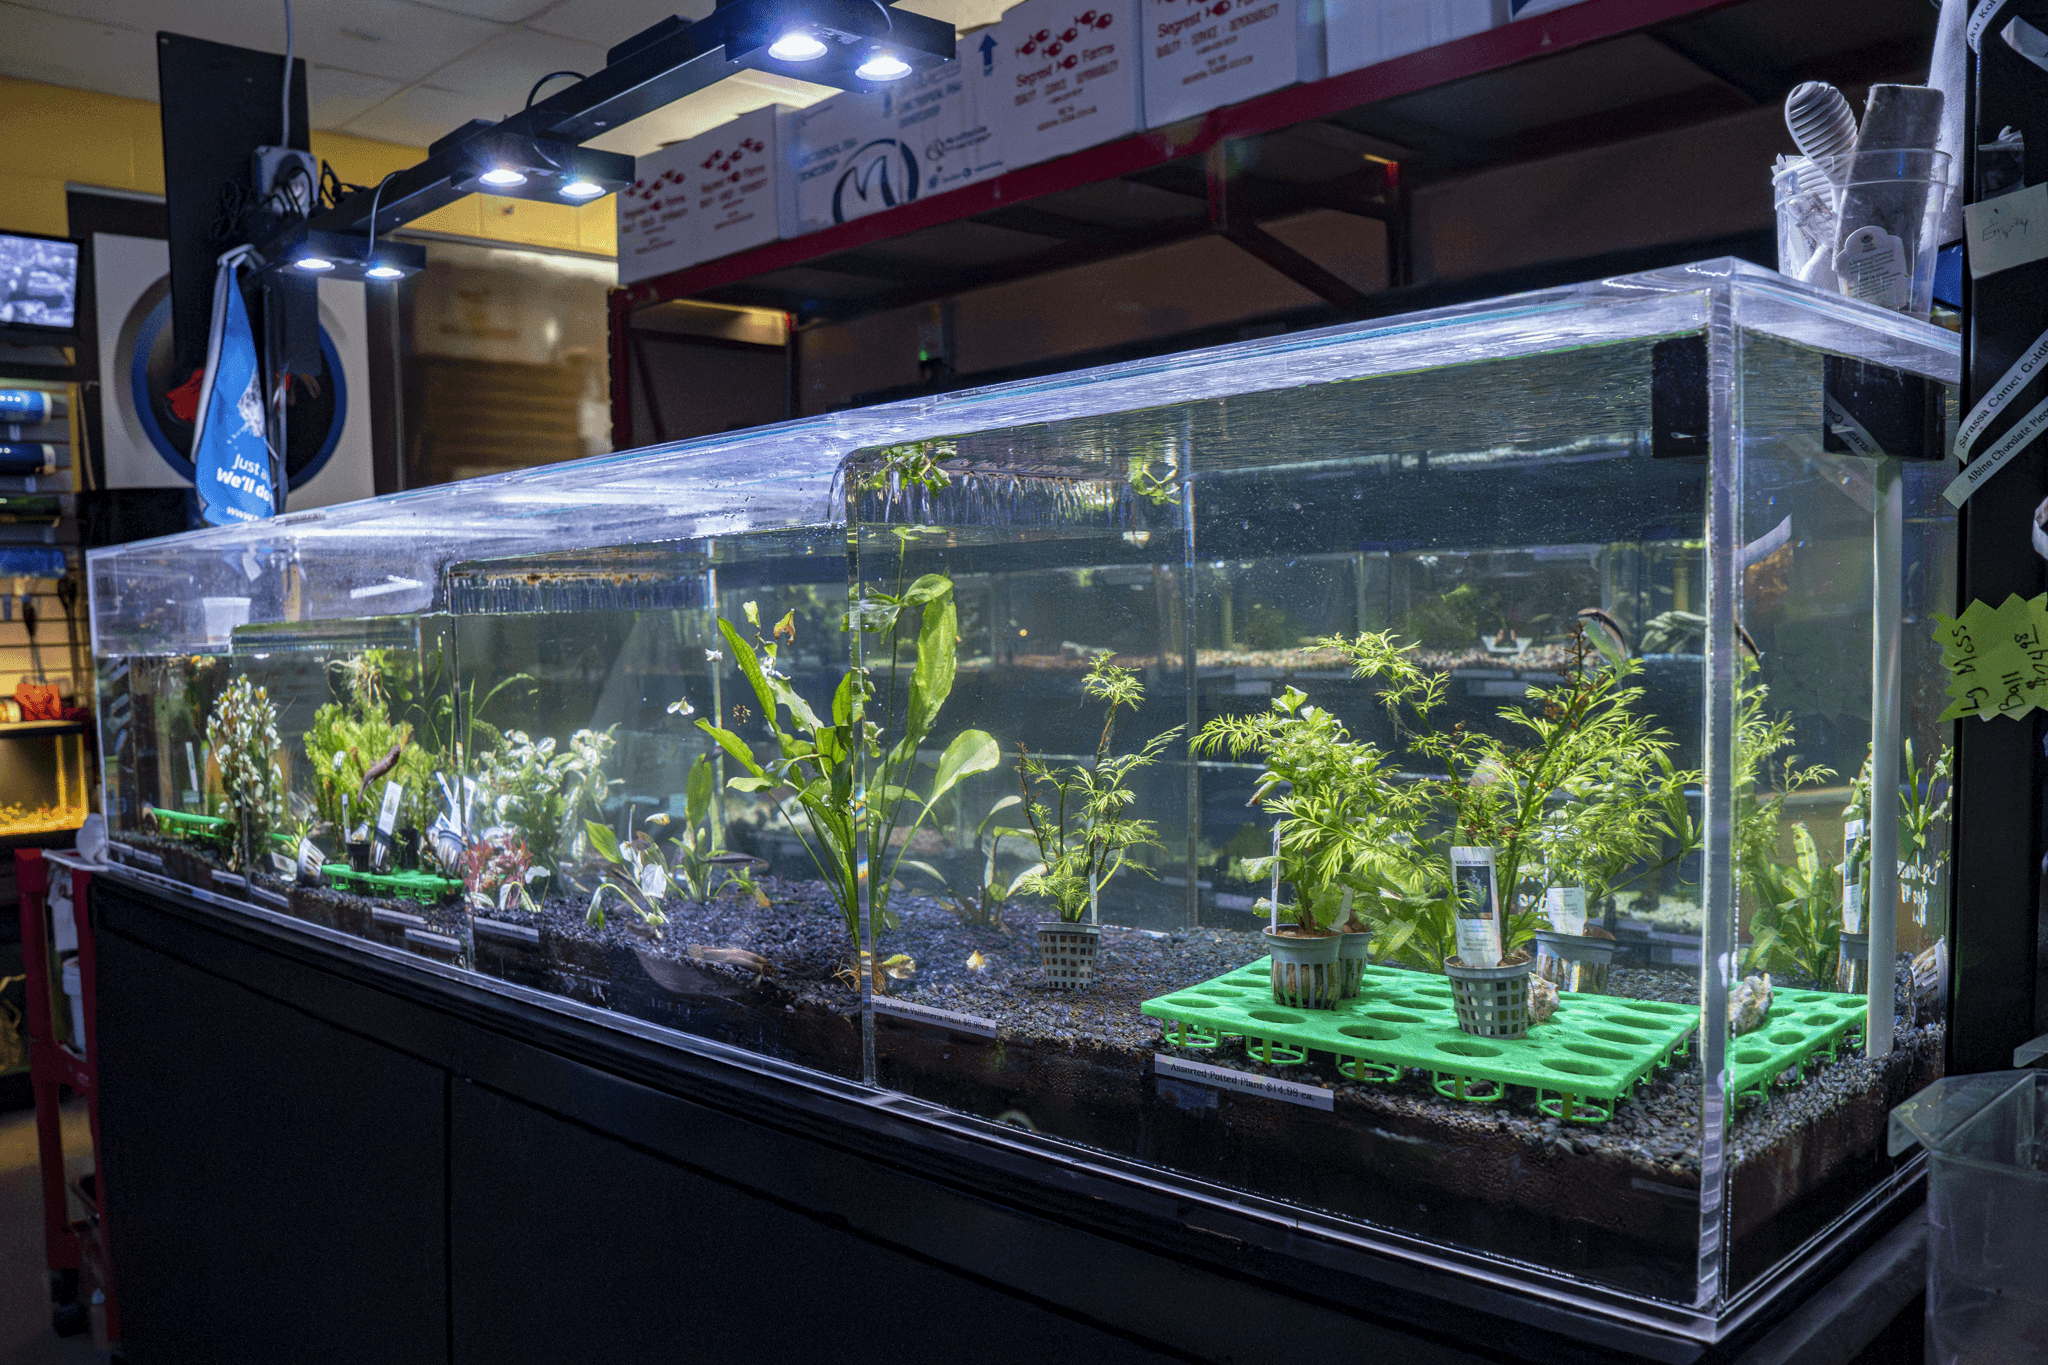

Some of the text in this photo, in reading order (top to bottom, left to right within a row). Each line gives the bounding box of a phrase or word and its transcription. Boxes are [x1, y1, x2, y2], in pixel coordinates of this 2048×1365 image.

[1157, 12, 1202, 38] Segrest
[1016, 44, 1115, 88] Segrest Farms
[1959, 408, 1990, 449] Sarassa
[1988, 374, 2023, 408] Comet
[1966, 459, 1994, 484] Albino
[1991, 424, 2032, 461] Chocolate
[217, 467, 255, 492] We'll
[1951, 625, 1978, 676] Moss
[1998, 671, 2026, 712] Ball
[888, 1003, 909, 1014] Jungle
[944, 1015, 962, 1026] Plant
[1170, 1062, 1316, 1102] Assorted Potted Plant $14.98 ea.
